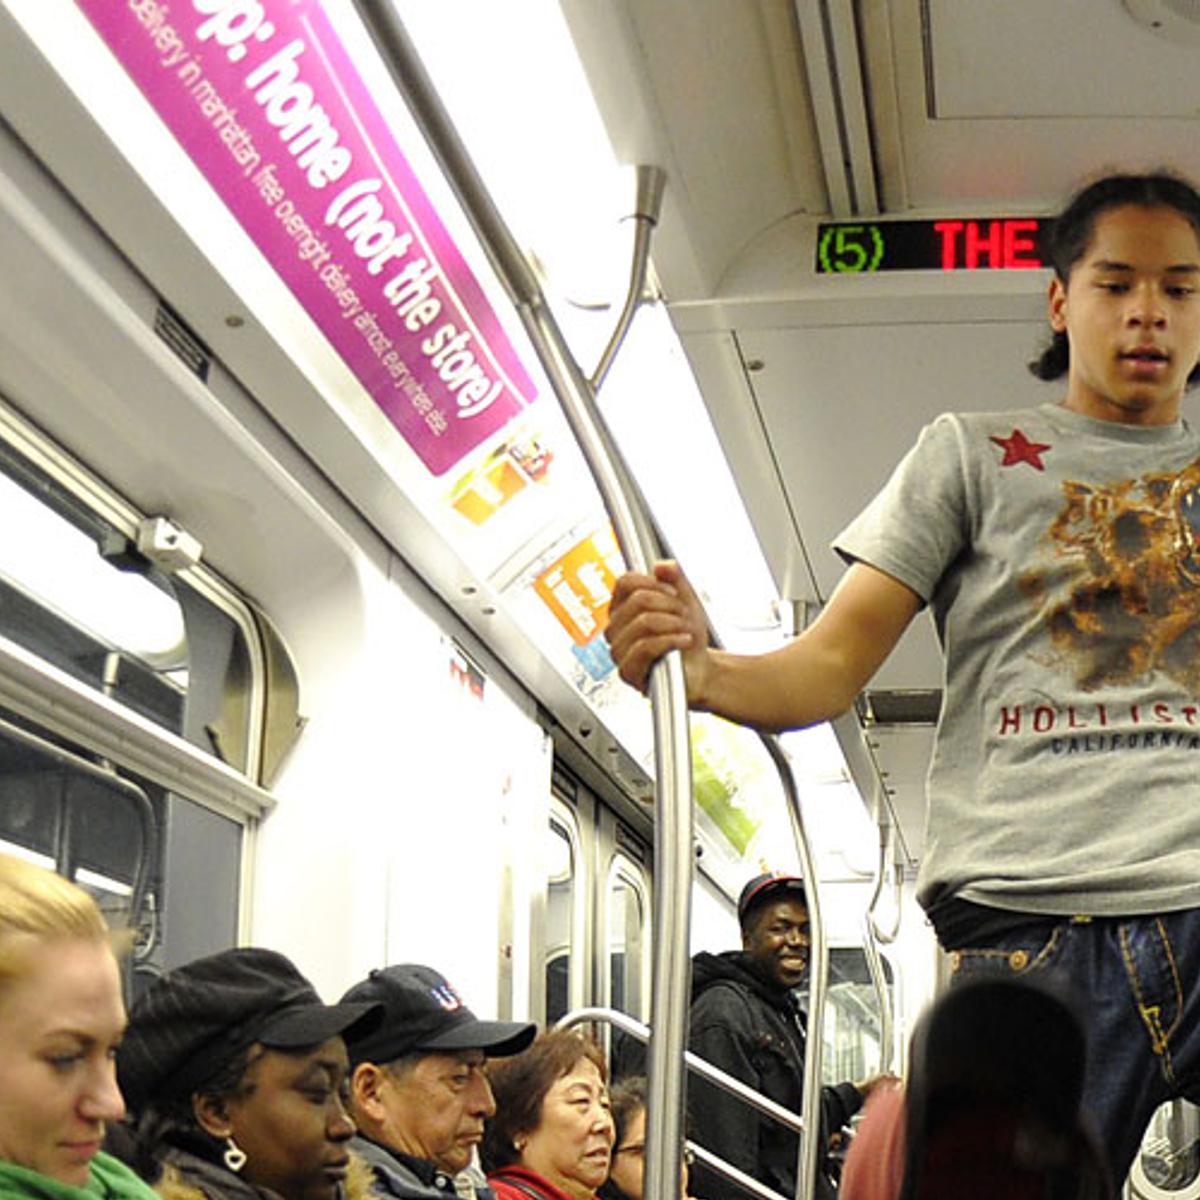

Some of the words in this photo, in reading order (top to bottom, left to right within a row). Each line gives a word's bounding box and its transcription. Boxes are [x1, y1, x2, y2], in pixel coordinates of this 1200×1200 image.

[177, 55, 202, 87] in
[252, 164, 284, 205] free
[275, 201, 331, 270] overnight
[320, 264, 363, 318] delivery
[354, 311, 392, 358] almost
[382, 351, 434, 418] everywhere
[245, 39, 352, 188] home
[324, 178, 413, 275] (not
[383, 258, 442, 332] the
[421, 323, 503, 418] store)
[818, 226, 884, 273] (5)
[934, 219, 1041, 271] THE
[1051, 730, 1200, 755] CALIFORNIA
